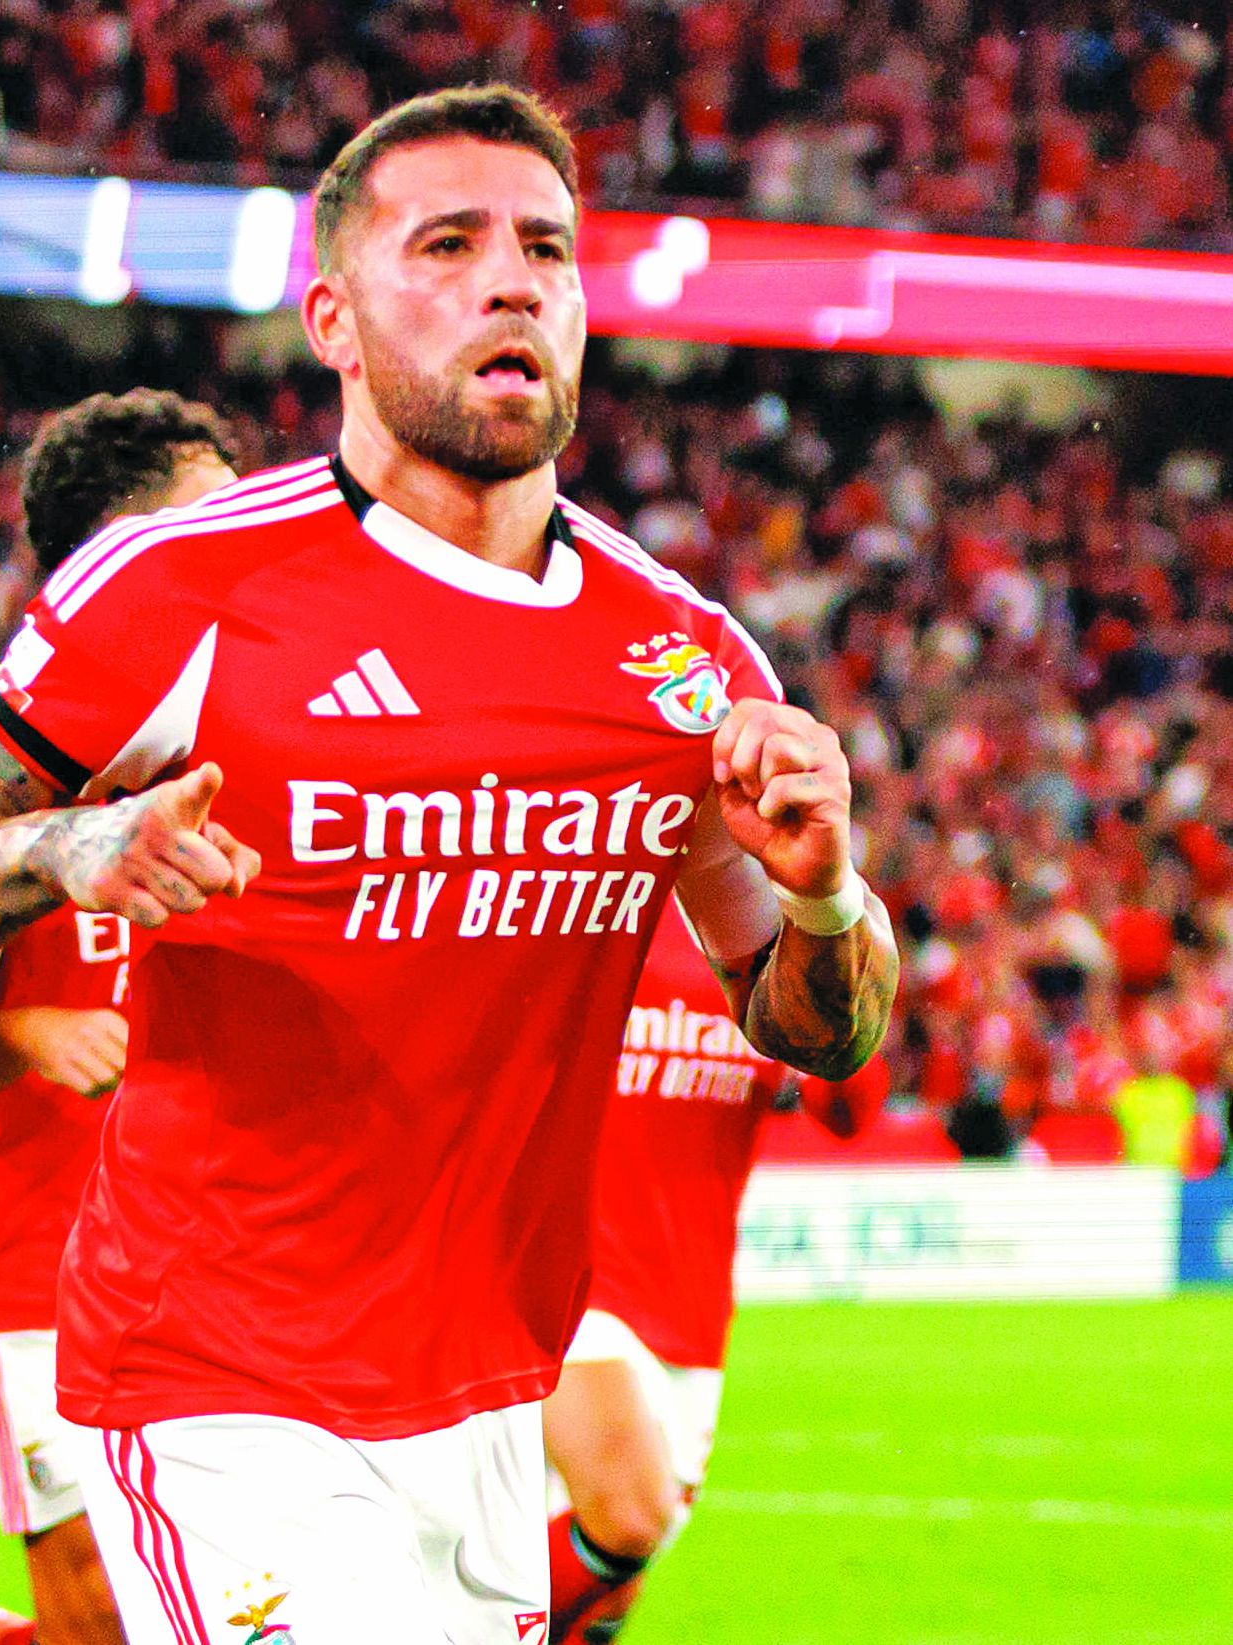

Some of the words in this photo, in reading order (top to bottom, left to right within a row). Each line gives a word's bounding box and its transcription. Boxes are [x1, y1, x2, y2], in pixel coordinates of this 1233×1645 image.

[287, 772, 694, 862] Emirate
[344, 871, 447, 940] FLY
[458, 869, 656, 938] BETTER
